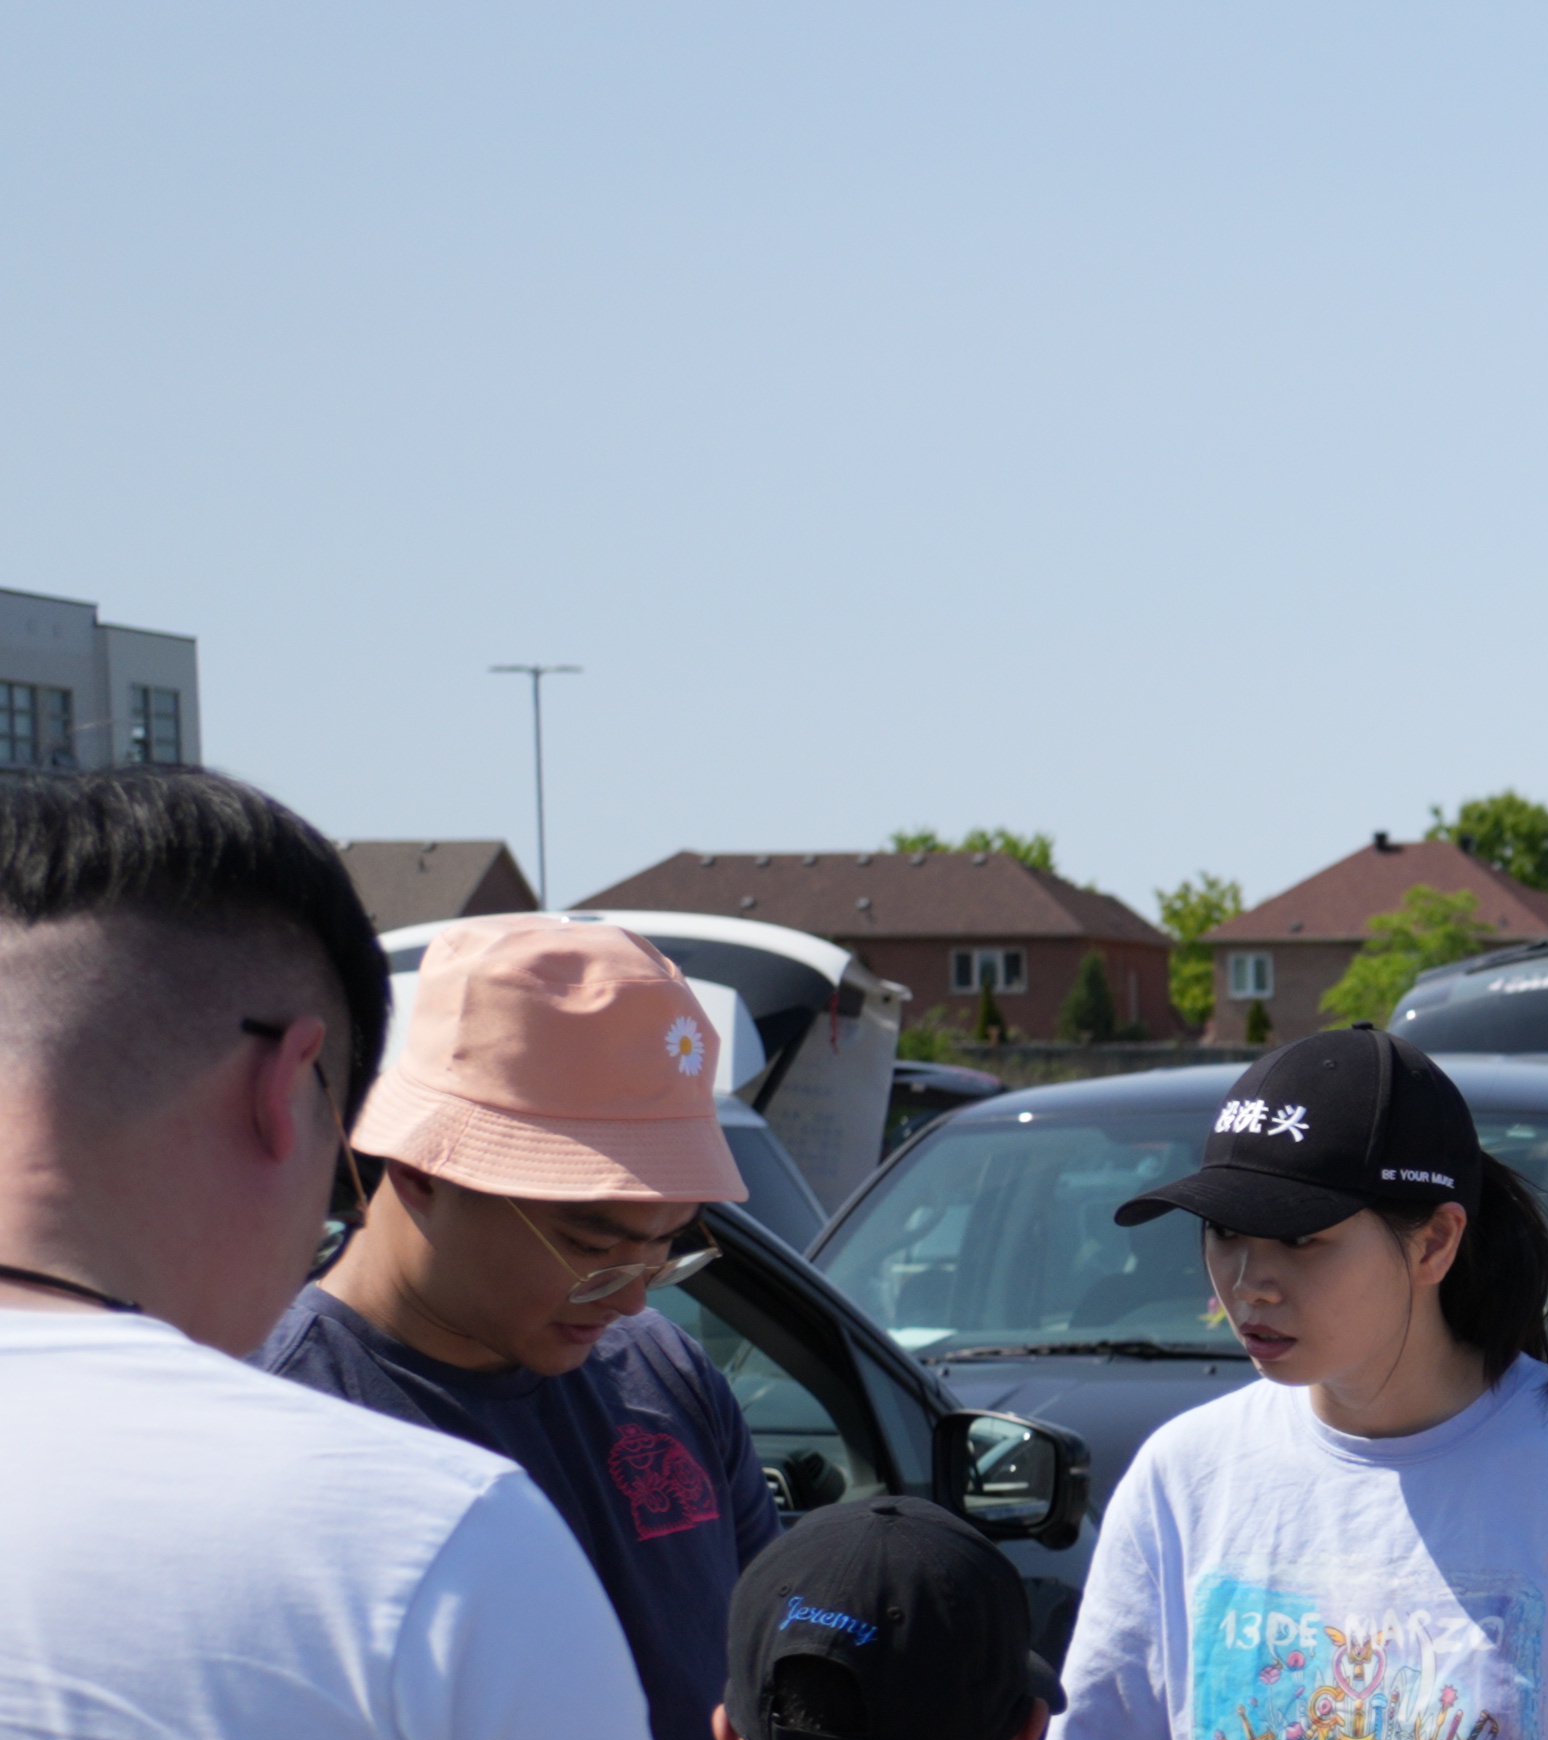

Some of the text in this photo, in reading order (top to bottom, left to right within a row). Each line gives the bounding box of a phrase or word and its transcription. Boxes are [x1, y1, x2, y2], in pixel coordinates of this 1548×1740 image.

[1381, 1168, 1397, 1181] BE
[1400, 1168, 1429, 1183] YOUR
[778, 1594, 880, 1647] Jeremy
[1344, 1607, 1505, 1656] MARZO
